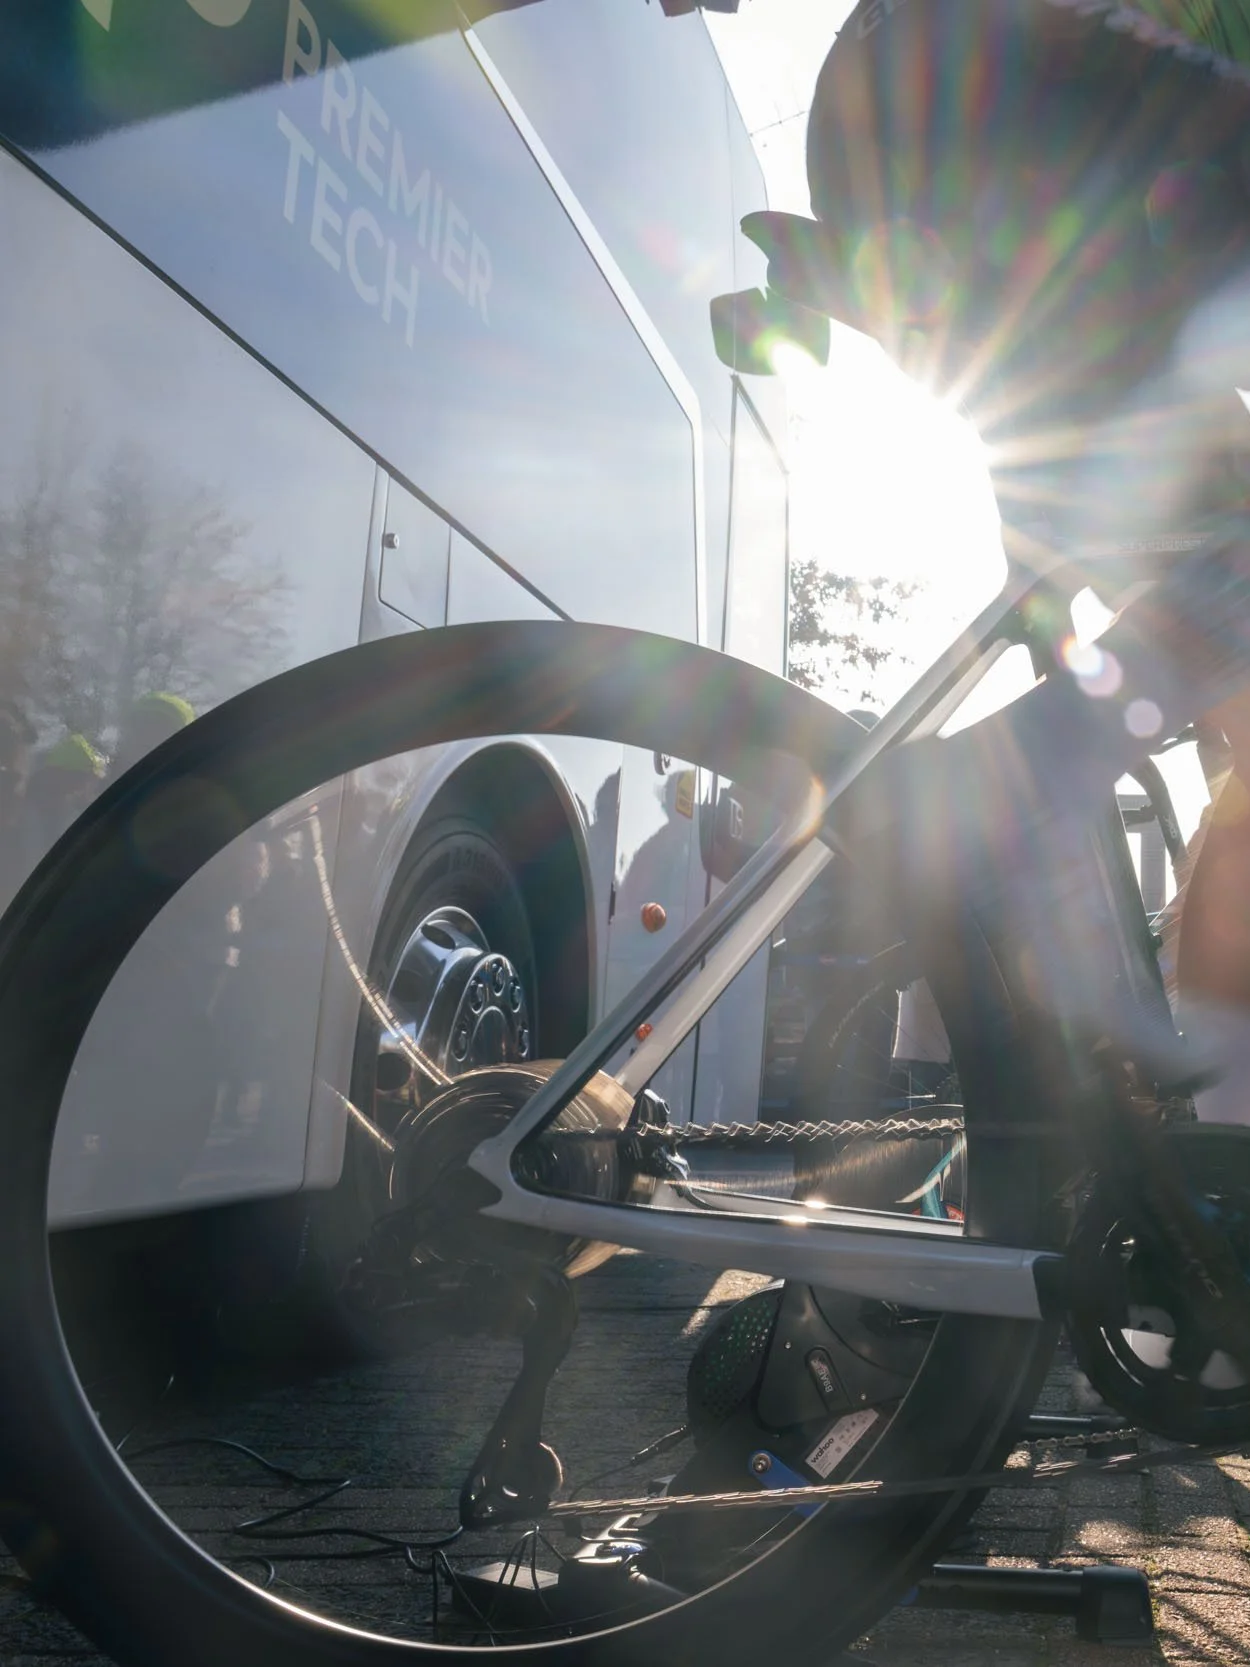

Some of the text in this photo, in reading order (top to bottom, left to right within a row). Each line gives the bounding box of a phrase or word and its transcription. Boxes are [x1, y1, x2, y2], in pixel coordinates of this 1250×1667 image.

[276, 109, 420, 350] TECH
[282, 0, 493, 328] PREMIER
[811, 1437, 835, 1464] wahoo
